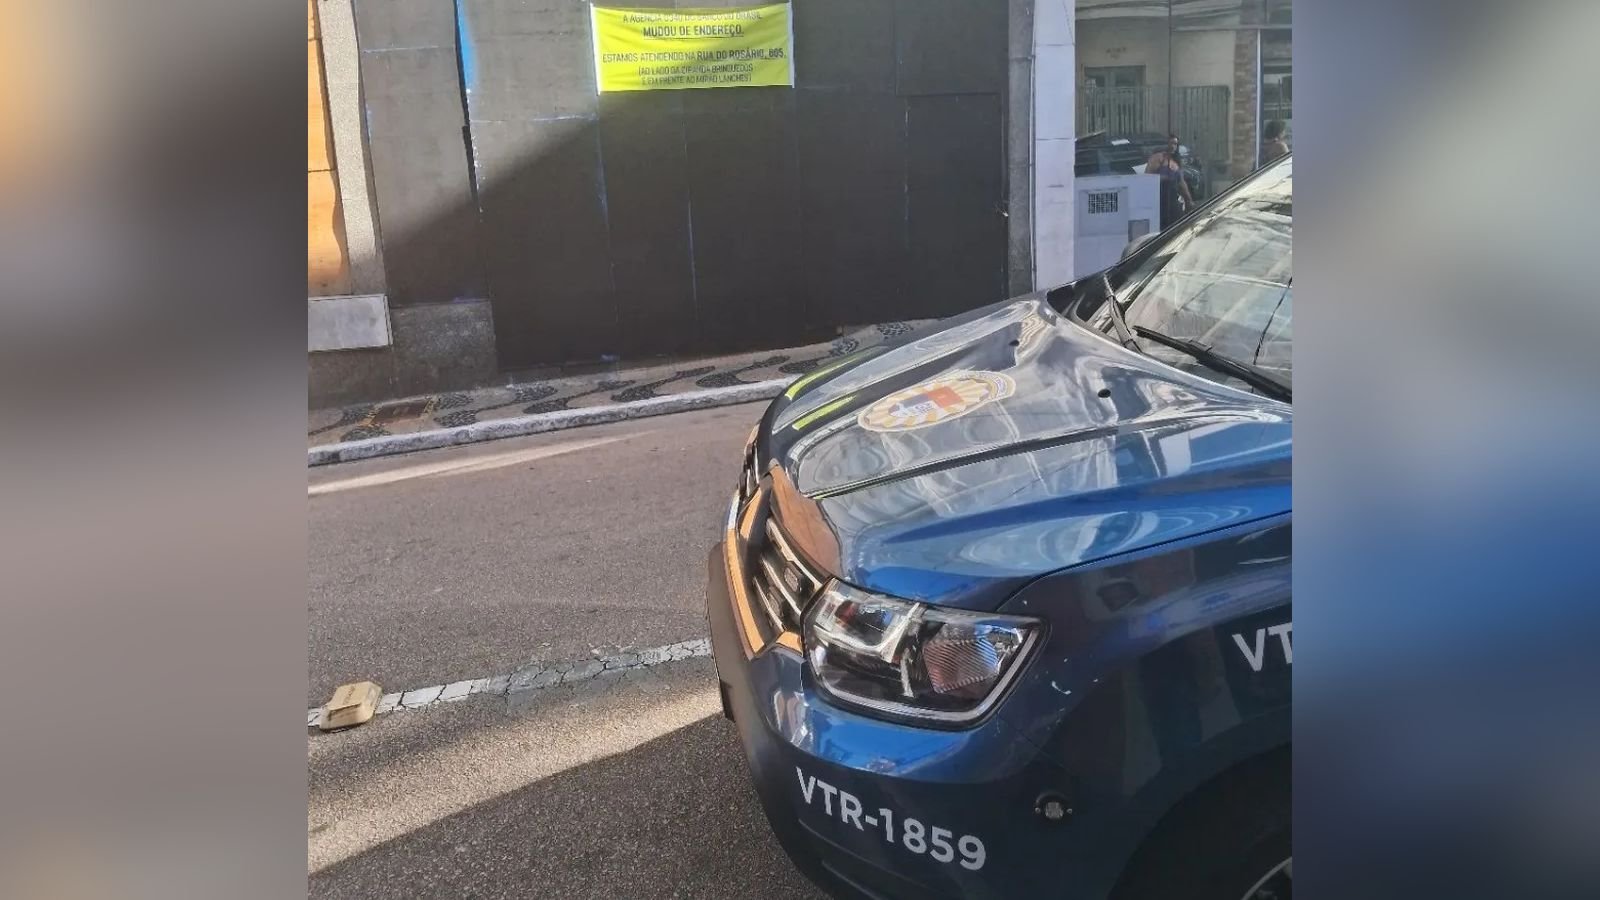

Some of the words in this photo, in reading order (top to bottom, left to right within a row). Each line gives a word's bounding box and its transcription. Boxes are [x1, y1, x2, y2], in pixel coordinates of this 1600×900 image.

[643, 26, 677, 37] MUDOU
[679, 26, 691, 36] DE
[602, 52, 639, 63] ESTAMOS
[640, 51, 684, 62] ATENDENDO
[685, 51, 696, 61] NA
[697, 50, 714, 60] RUA
[716, 50, 728, 60] DO
[796, 766, 987, 871] VTR-1859
